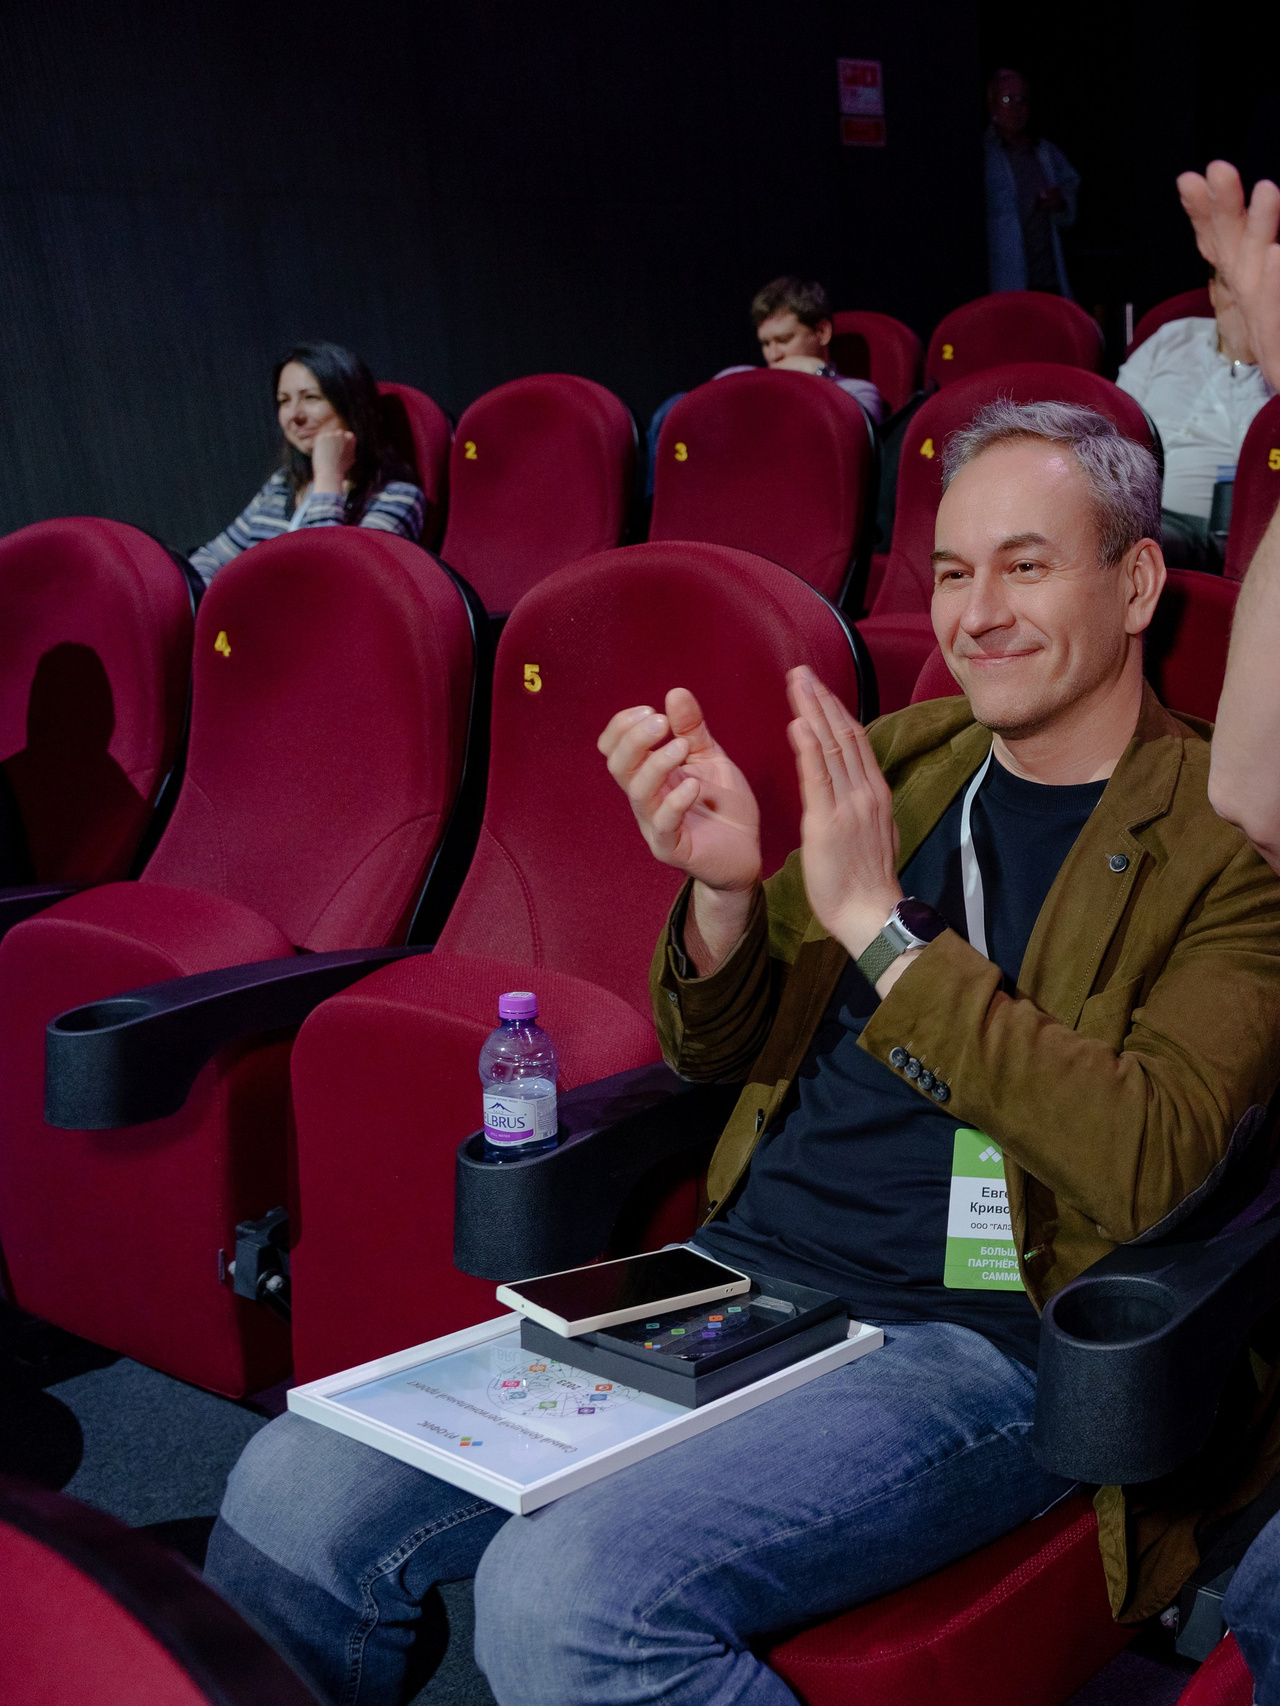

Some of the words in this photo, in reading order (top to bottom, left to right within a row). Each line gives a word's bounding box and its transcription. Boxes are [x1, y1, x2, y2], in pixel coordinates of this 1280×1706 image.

[465, 441, 478, 459] 2
[675, 442, 689, 461] 3
[920, 437, 935, 460] 4
[214, 631, 231, 657] 4
[524, 663, 542, 693] 5
[970, 1222, 988, 1230] ООО
[556, 1379, 582, 1391] 2023
[435, 1392, 503, 1424] региональный
[499, 1419, 544, 1442] большой
[541, 1437, 578, 1454] Самый
